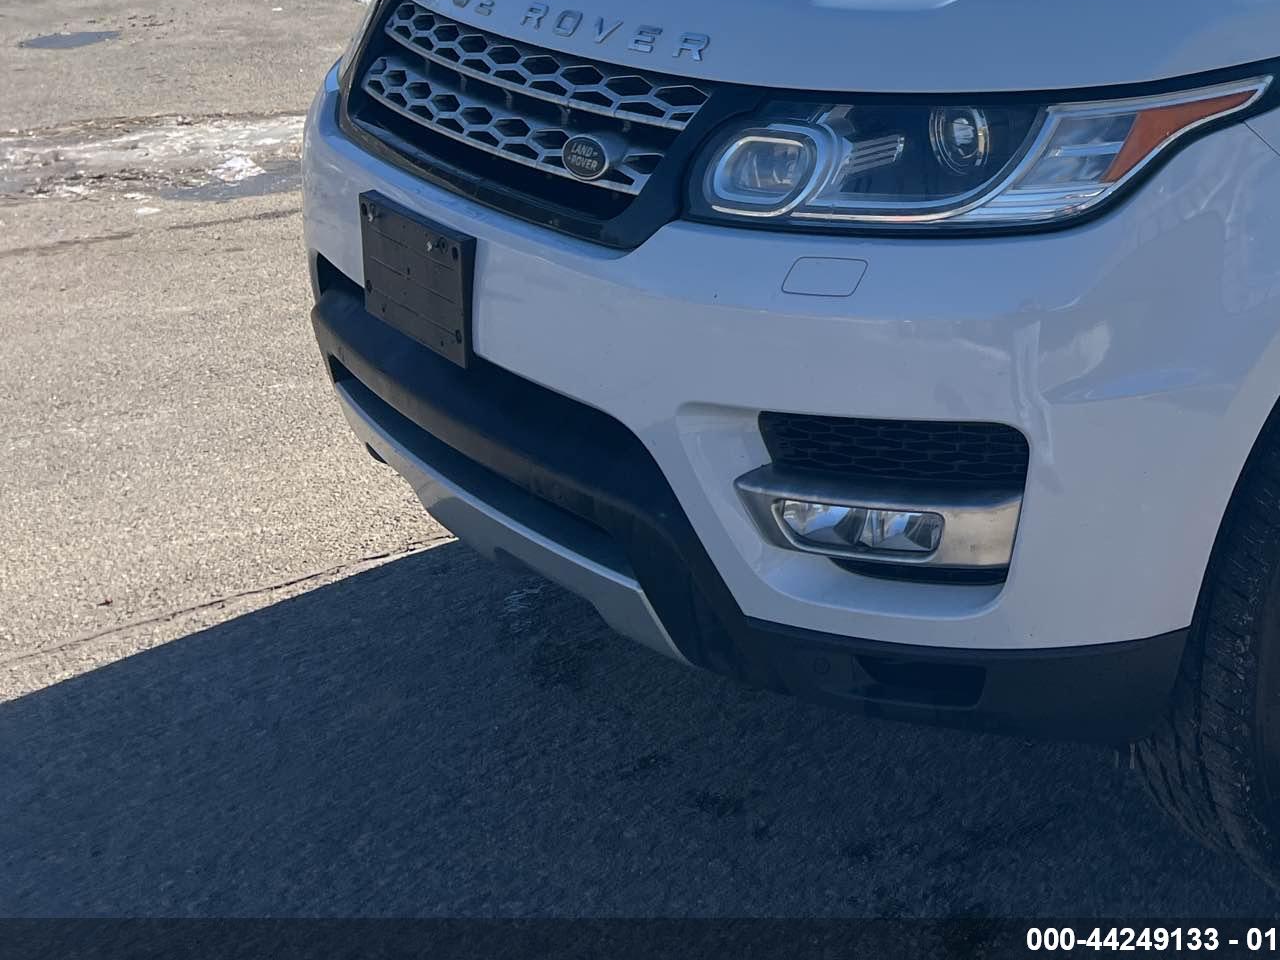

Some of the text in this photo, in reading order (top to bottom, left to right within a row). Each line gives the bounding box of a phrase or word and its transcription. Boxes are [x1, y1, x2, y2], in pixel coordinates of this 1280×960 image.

[519, 1, 712, 63] ROVER
[571, 142, 594, 157] LAND
[570, 154, 599, 171] ROVER
